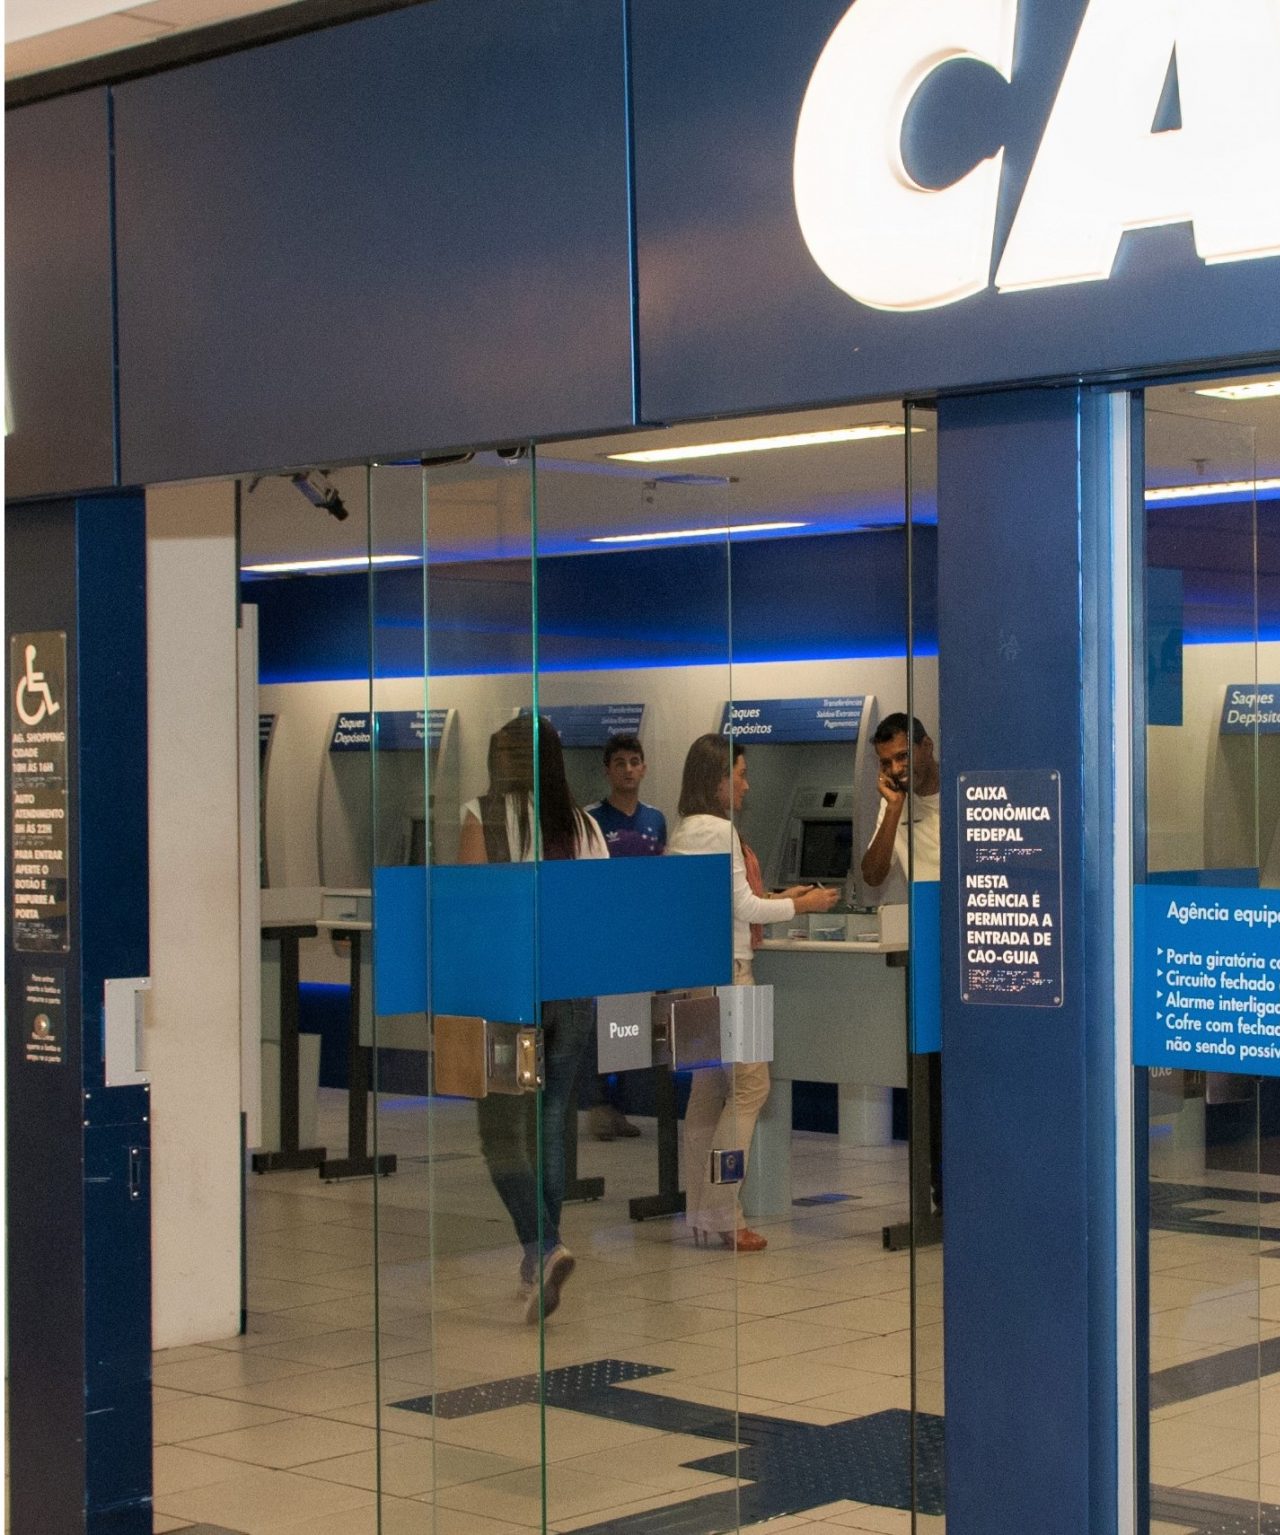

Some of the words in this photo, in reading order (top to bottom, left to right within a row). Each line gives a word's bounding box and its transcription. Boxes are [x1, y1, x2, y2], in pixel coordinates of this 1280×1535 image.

[1231, 691, 1274, 707] Saques
[27, 732, 66, 743] SHOPPING
[334, 732, 371, 745] Depósito
[966, 786, 1008, 801] CAIXA
[14, 808, 65, 819] ATENDIMENTO
[966, 803, 1051, 821] ECONÔMICA
[966, 875, 1008, 889] NESTA
[967, 890, 1029, 908] AGÊNCIA
[967, 912, 1039, 927] PERMITIDA
[1042, 913, 1052, 927] A
[1166, 900, 1229, 924] Agência
[967, 931, 1030, 945] ENTRADA
[1033, 932, 1052, 946] DE
[1166, 948, 1202, 966] Porta
[1206, 950, 1265, 971] giratória
[1166, 970, 1216, 988] Circuito
[1220, 971, 1275, 992] fechado
[1165, 991, 1215, 1010] Alarme
[609, 1022, 639, 1039] Puxe
[1165, 1013, 1201, 1031] Cofre
[1205, 1020, 1233, 1033] com
[1166, 1036, 1191, 1052] não
[1195, 1038, 1236, 1055] sendo
[1148, 1065, 1173, 1078] uxe
